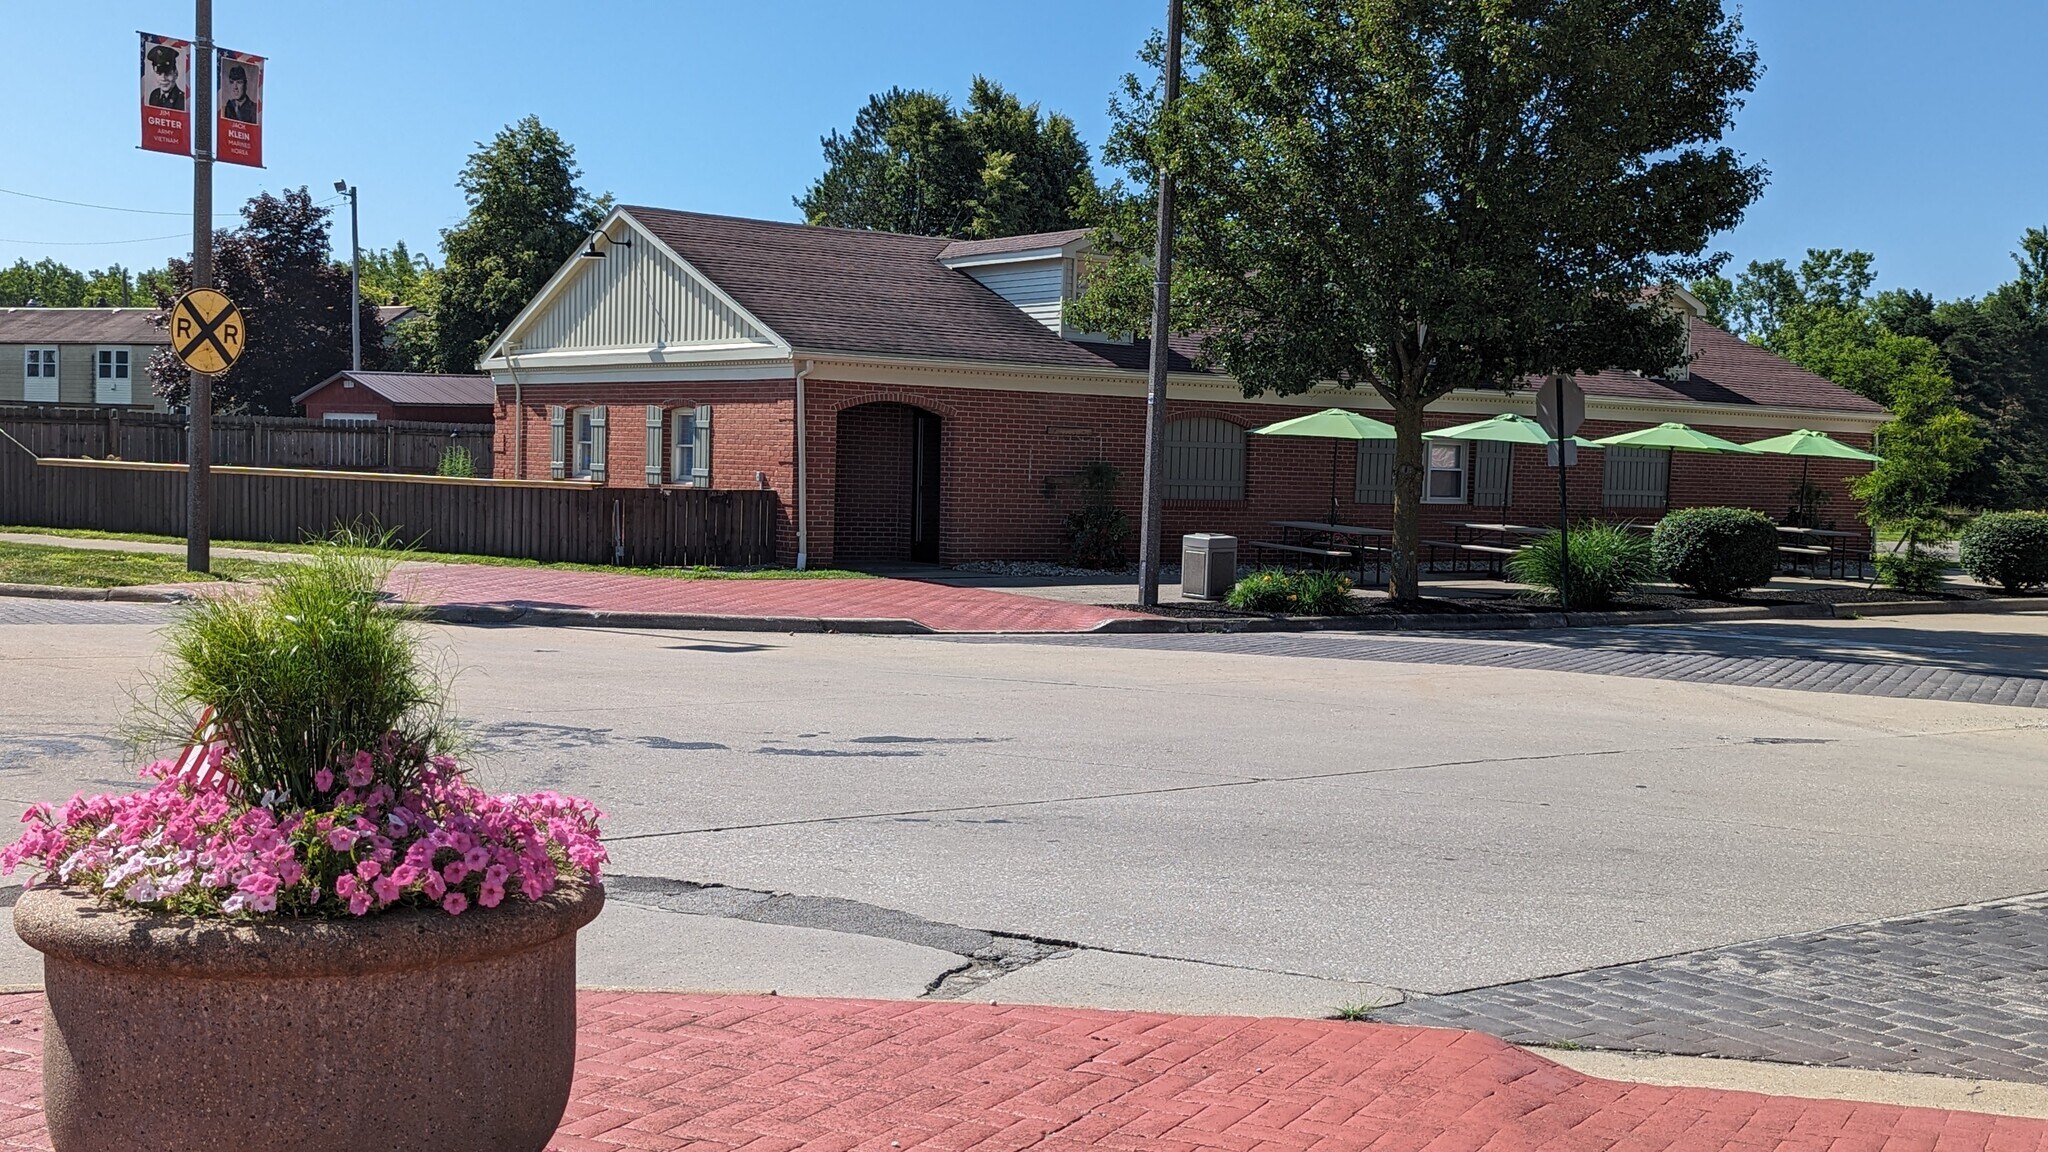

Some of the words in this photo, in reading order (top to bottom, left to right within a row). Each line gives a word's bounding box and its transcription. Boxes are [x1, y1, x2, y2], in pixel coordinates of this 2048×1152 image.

[148, 116, 182, 129] GRETER
[232, 122, 246, 130] JACK
[153, 136, 179, 144] VIETNAM
[228, 130, 250, 140] KLEIN
[177, 318, 191, 338] R
[224, 324, 238, 345] R
